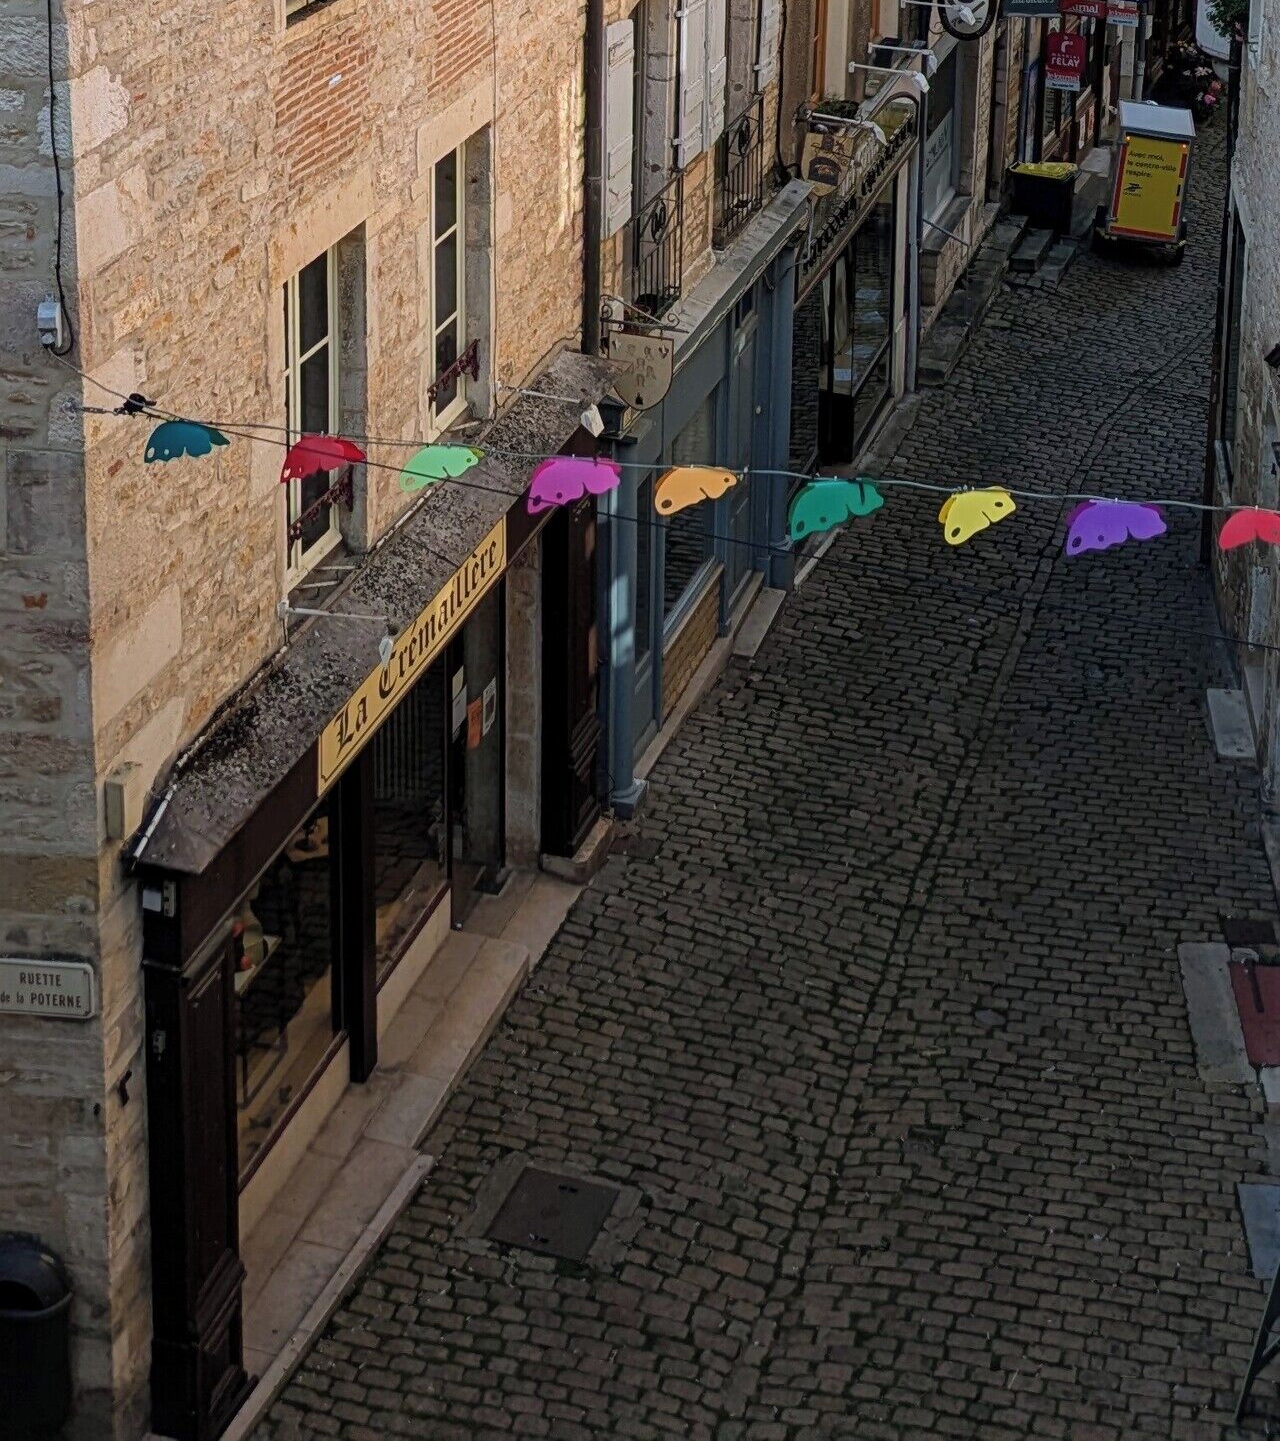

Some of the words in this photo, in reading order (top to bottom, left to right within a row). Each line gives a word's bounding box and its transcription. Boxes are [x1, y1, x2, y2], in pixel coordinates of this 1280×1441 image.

[1125, 169, 1152, 178] respire.
[1135, 162, 1177, 172] centre-ville
[333, 695, 369, 758] La
[378, 539, 497, 699] Crémaillère
[20, 972, 61, 986] RUETTE
[0, 991, 11, 1004] de
[16, 991, 25, 1005] la
[31, 993, 81, 1007] POTERNE
